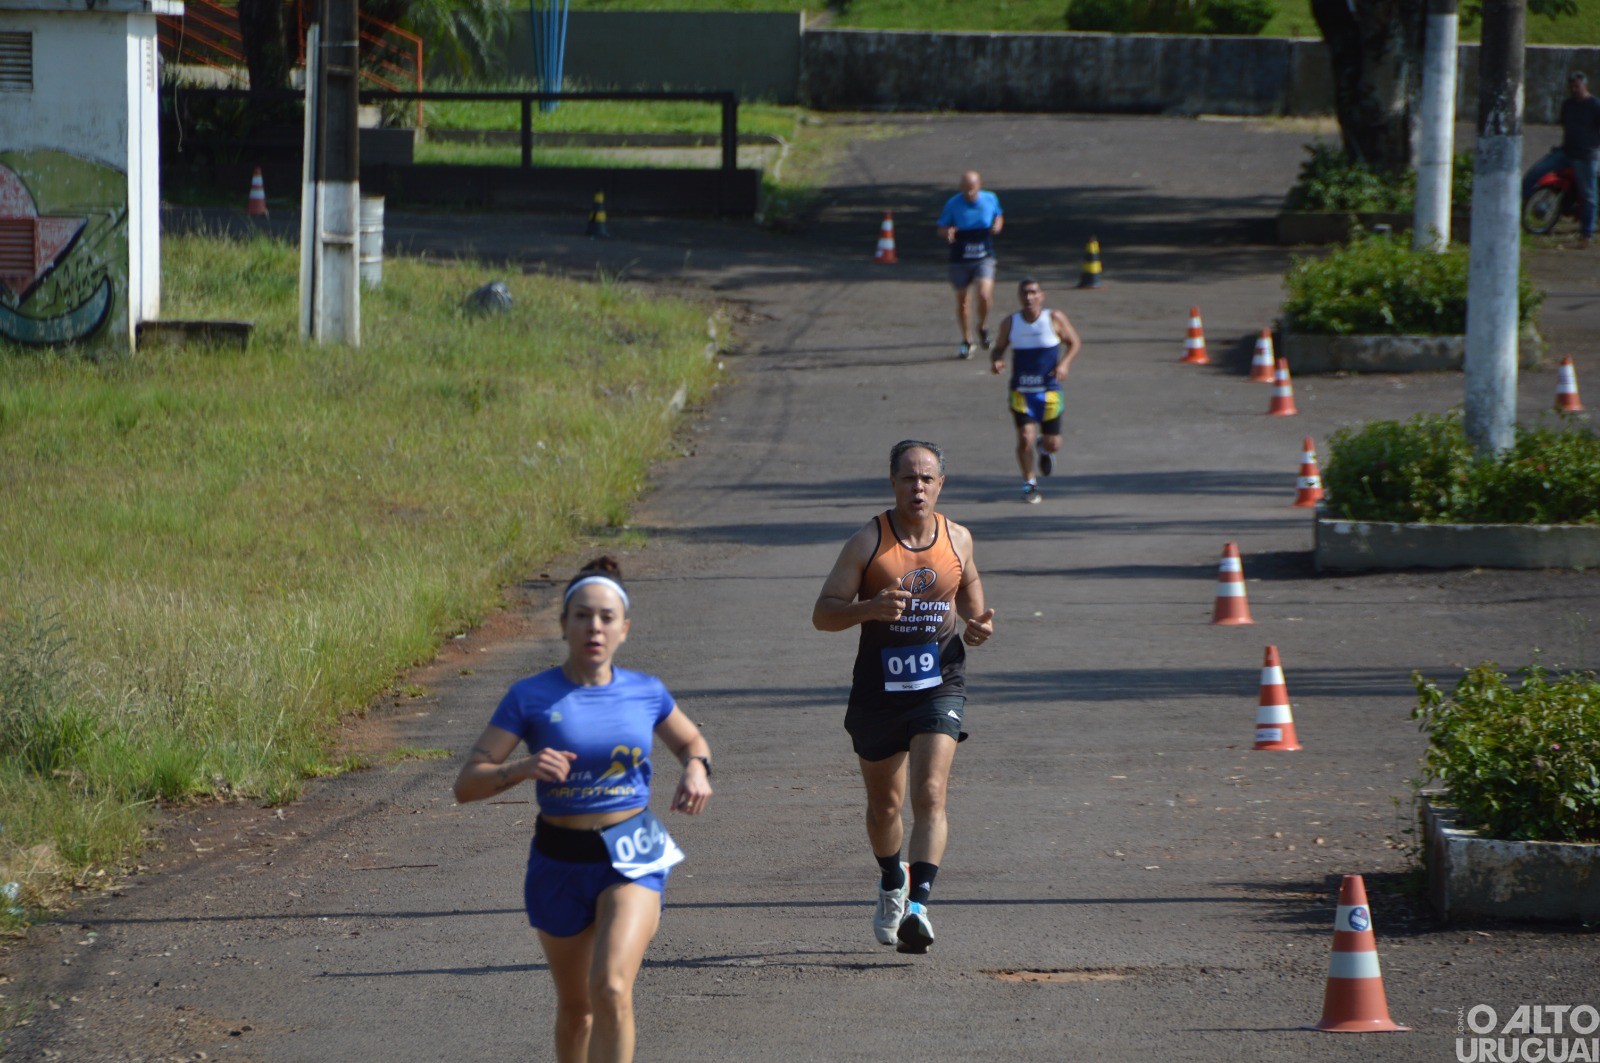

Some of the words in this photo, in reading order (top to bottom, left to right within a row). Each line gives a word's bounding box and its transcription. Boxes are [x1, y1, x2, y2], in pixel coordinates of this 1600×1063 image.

[910, 598, 950, 611] Forma
[899, 613, 943, 623] ademia
[925, 625, 937, 633] RS
[887, 652, 935, 675] 019
[615, 819, 665, 862] 064
